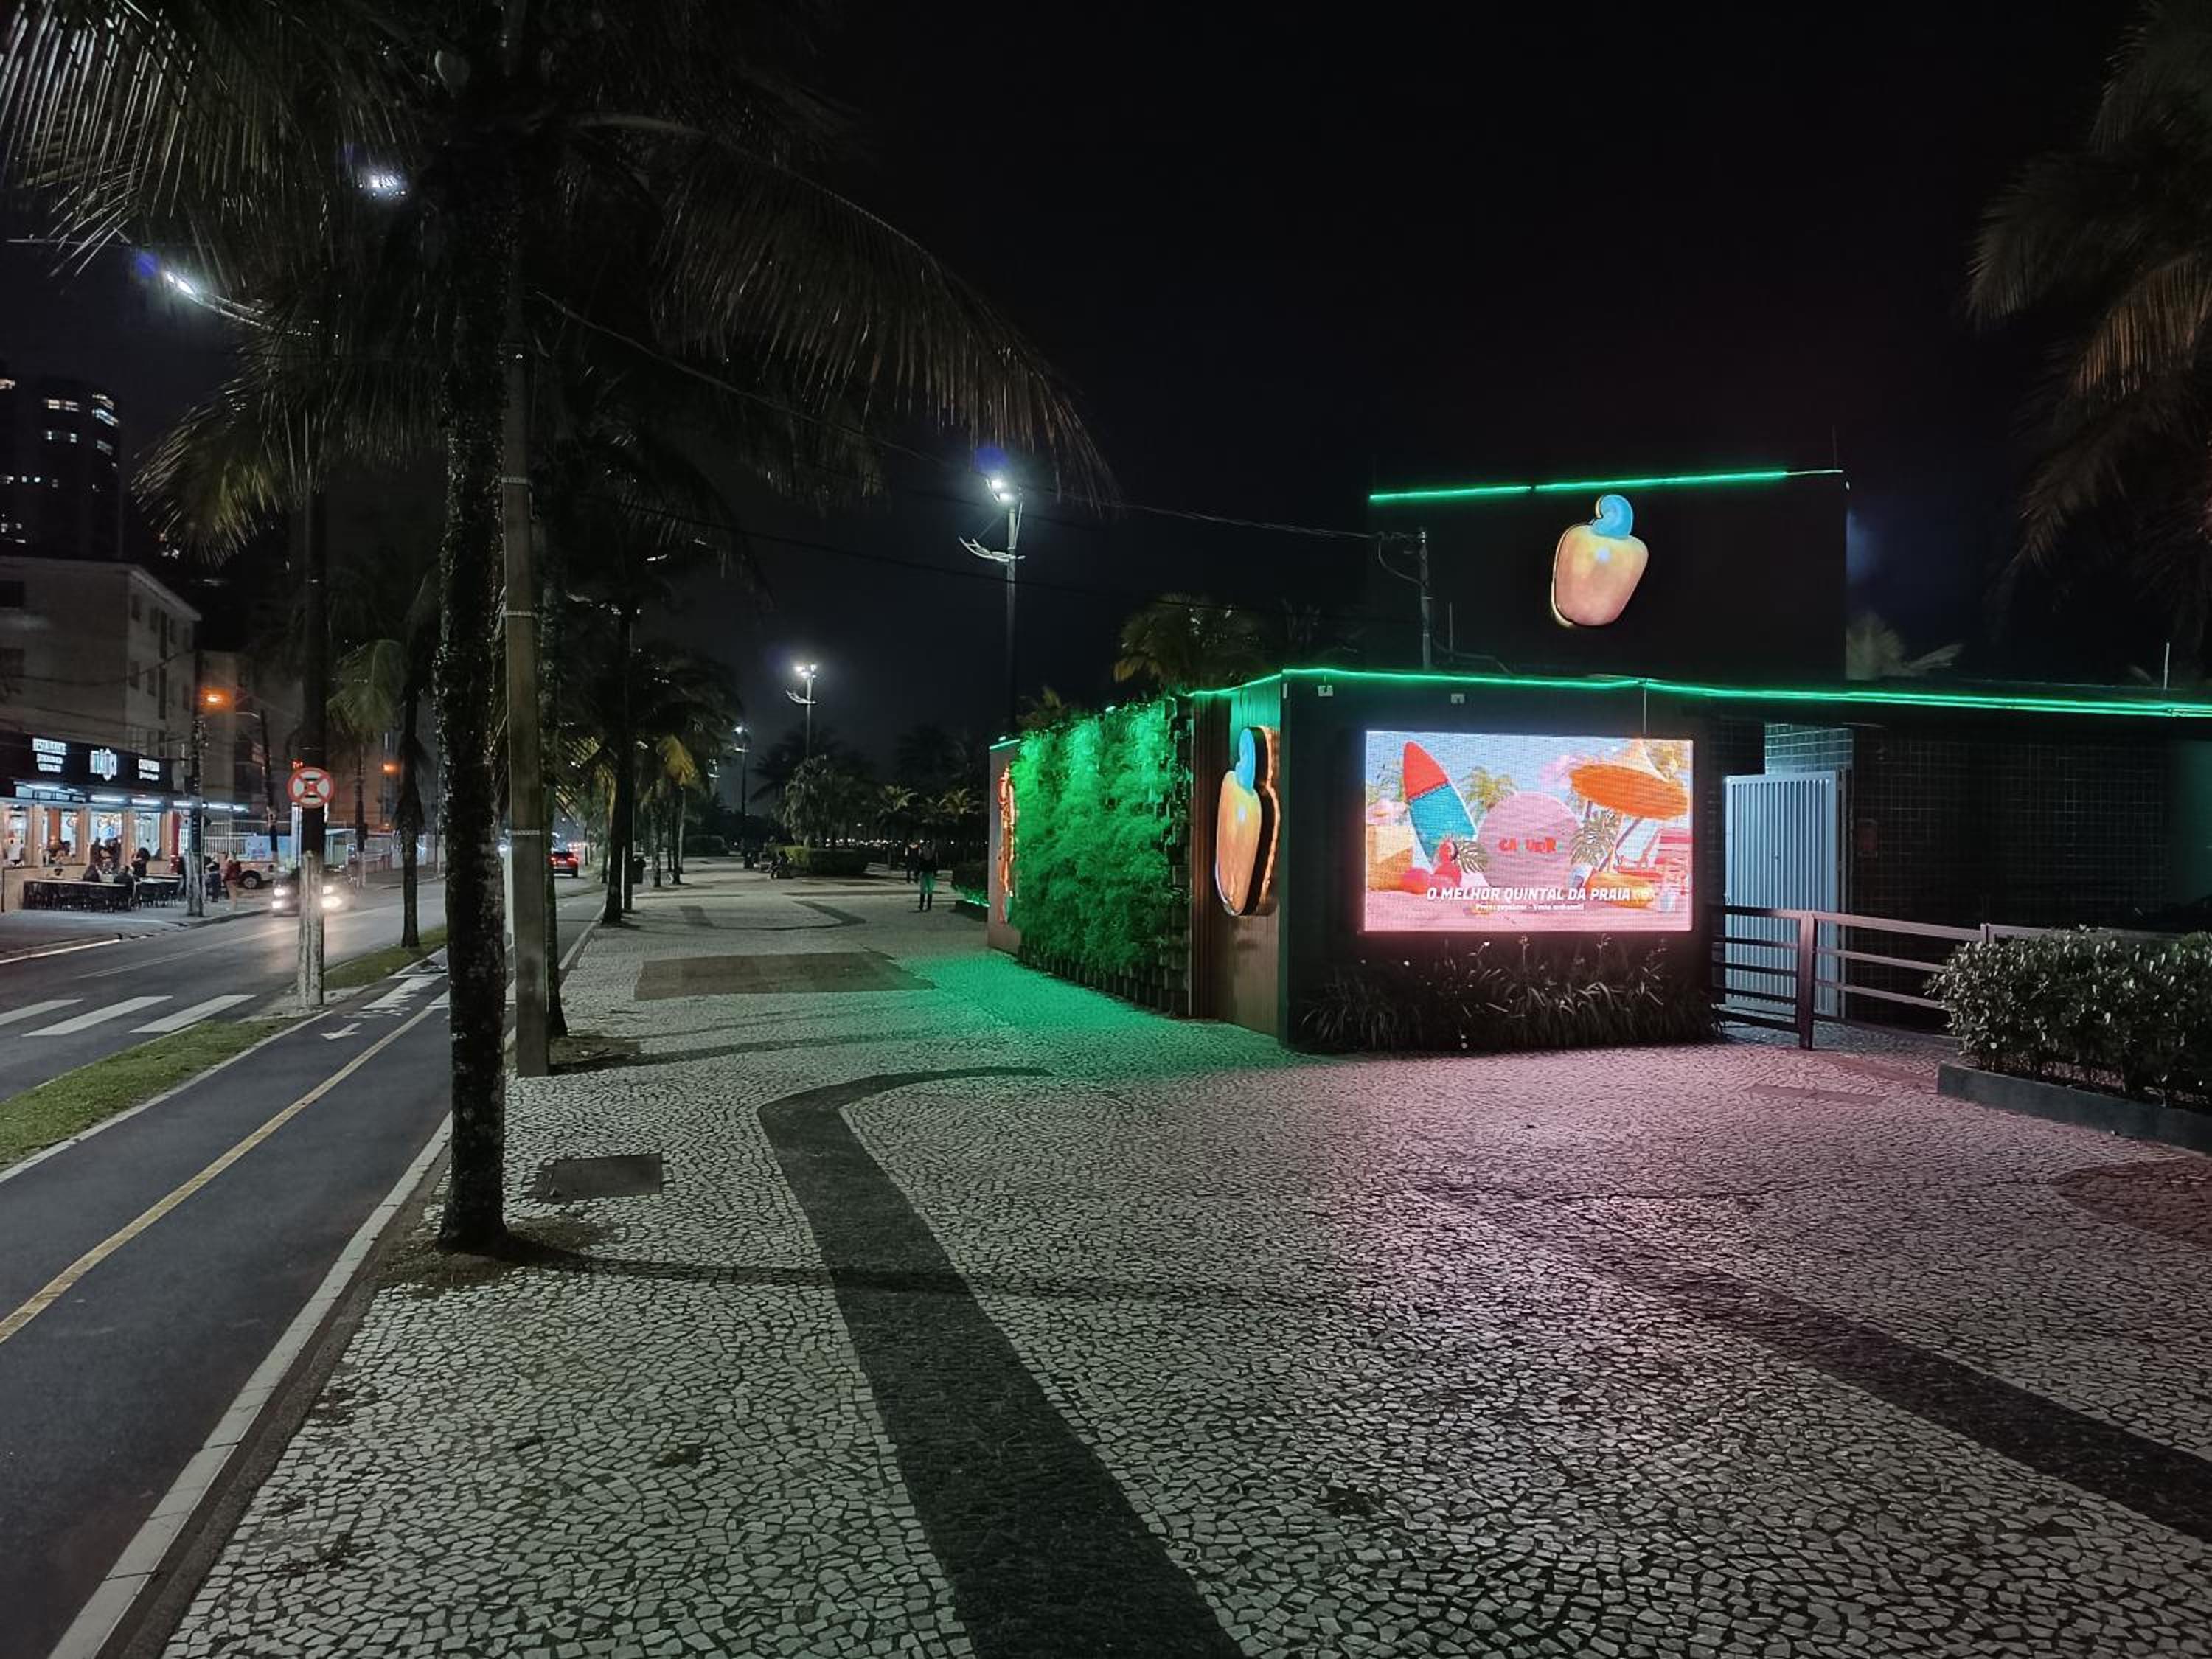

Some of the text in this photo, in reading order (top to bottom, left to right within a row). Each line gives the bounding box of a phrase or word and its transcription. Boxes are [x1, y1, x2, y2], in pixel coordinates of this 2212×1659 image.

[1427, 887, 1630, 902] O MELHOR QUINTAL DA PRAIA
